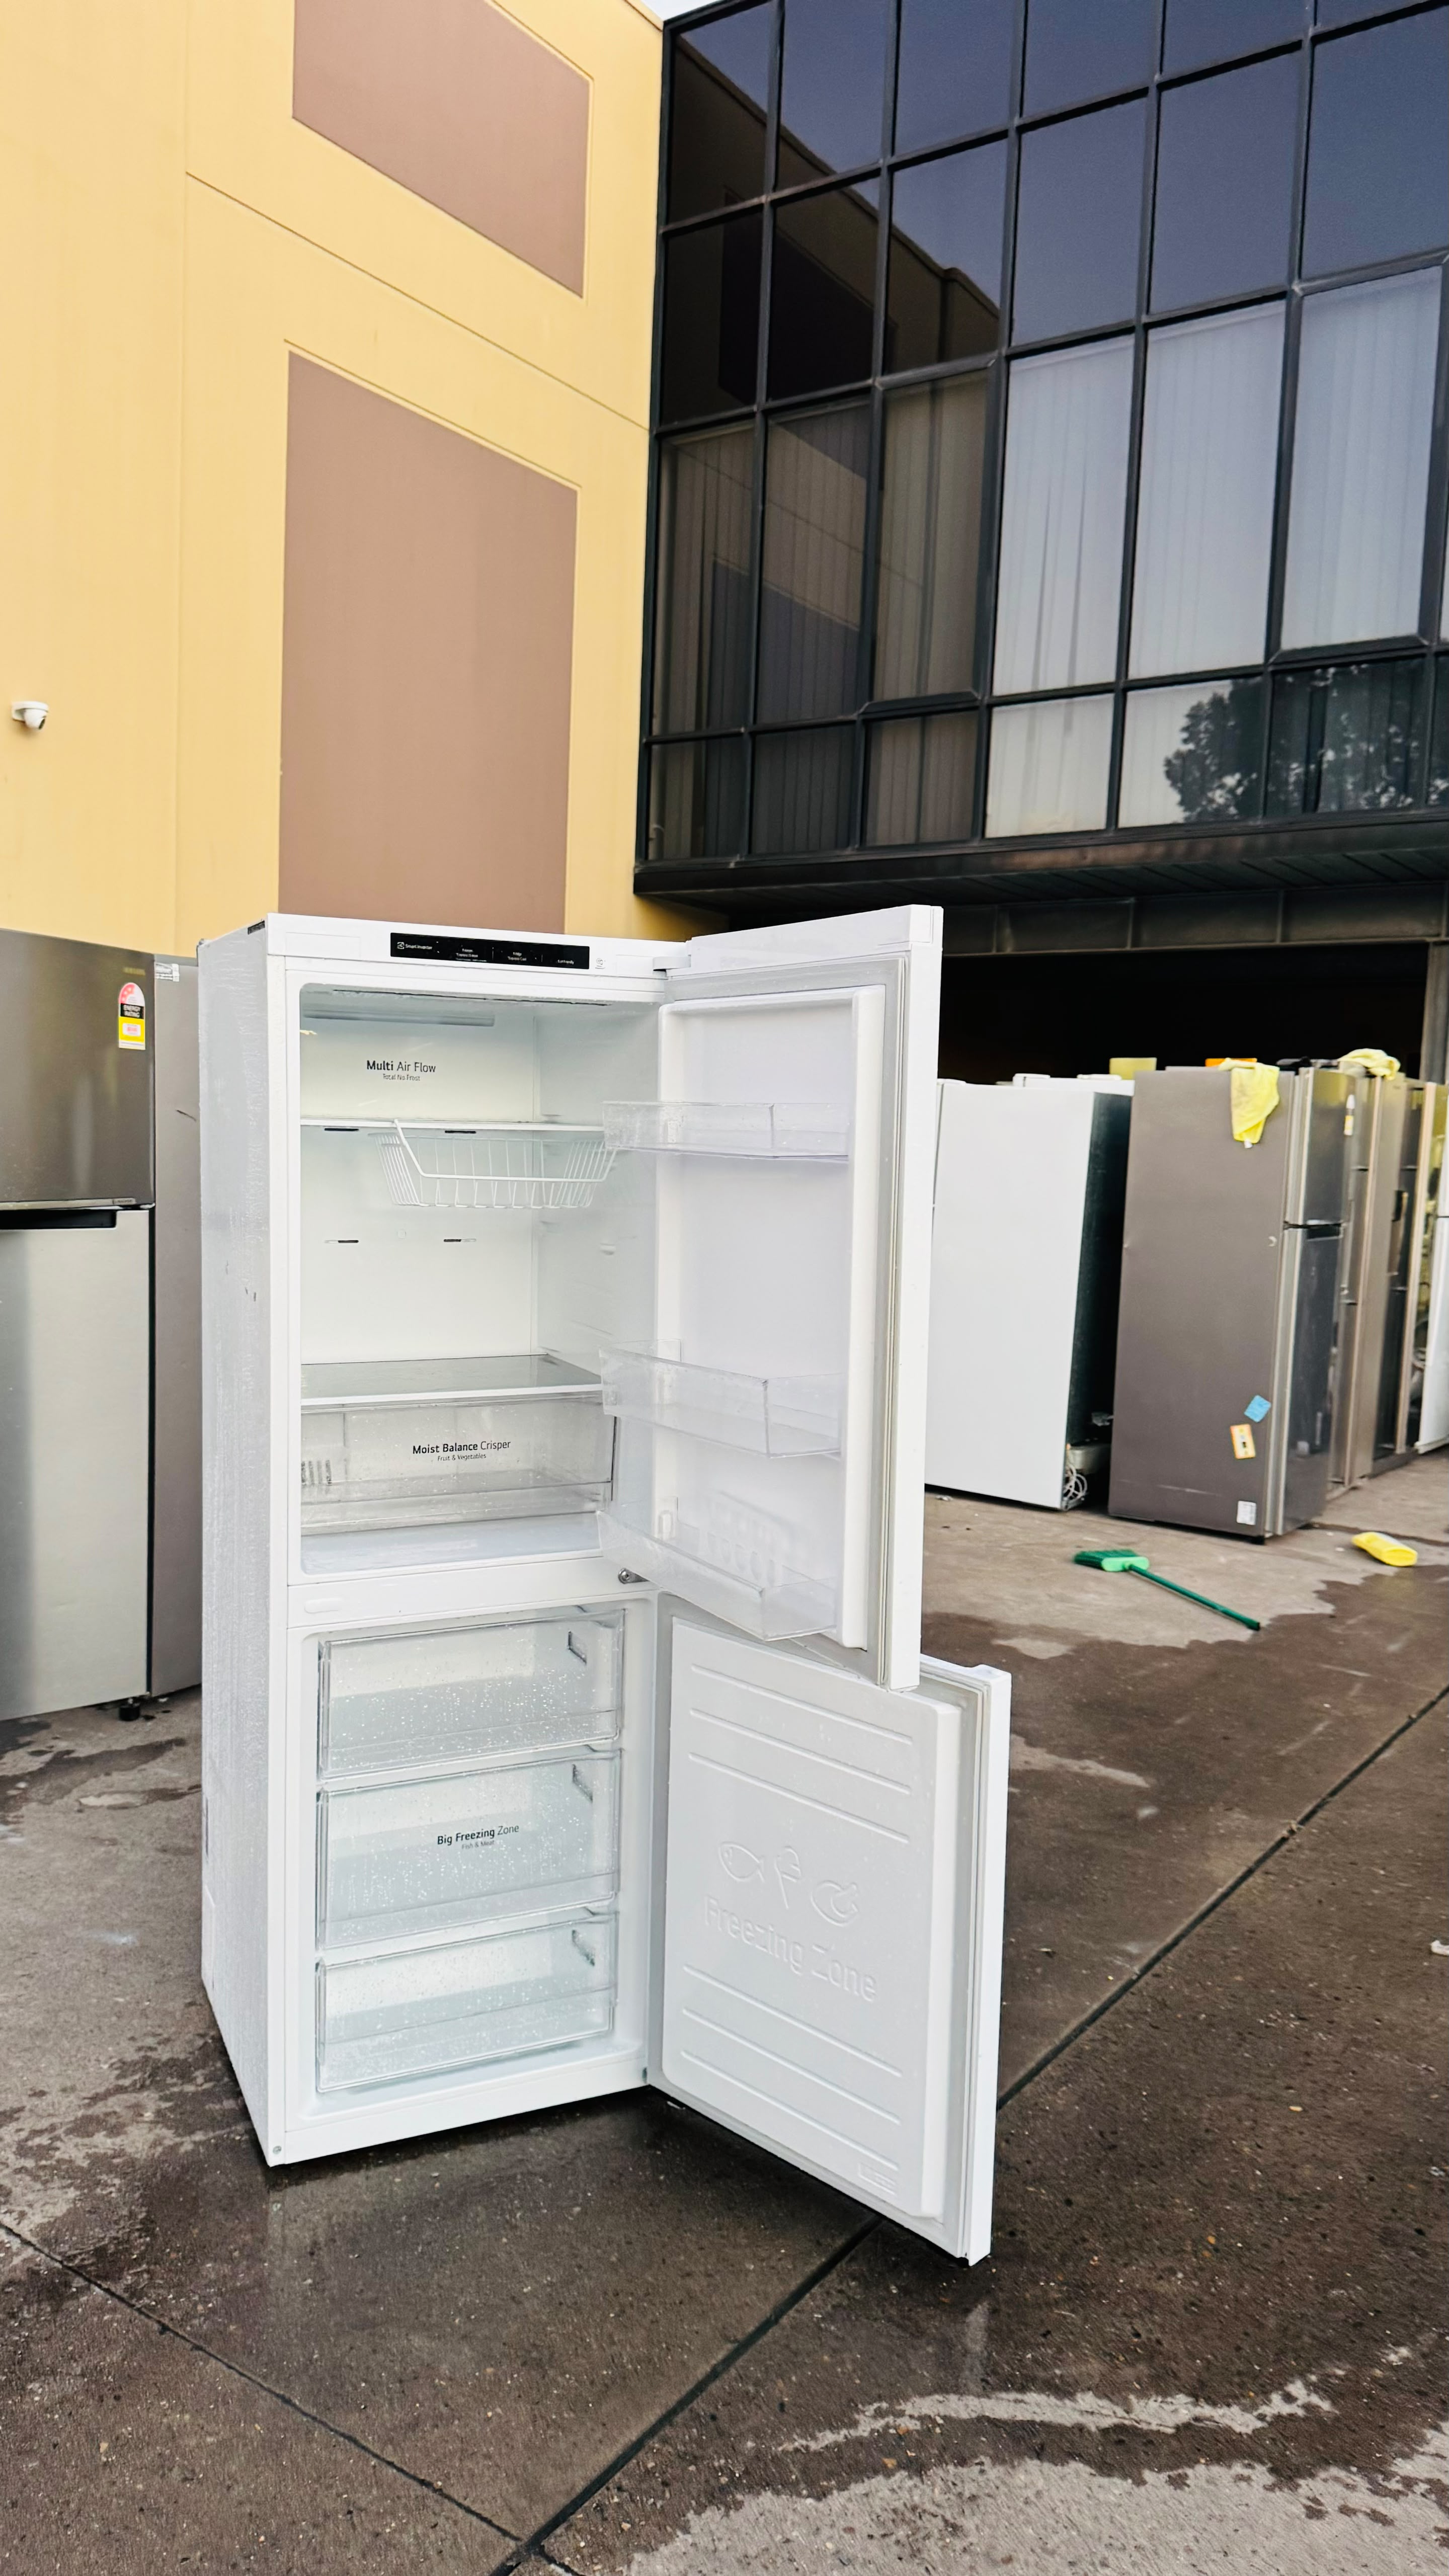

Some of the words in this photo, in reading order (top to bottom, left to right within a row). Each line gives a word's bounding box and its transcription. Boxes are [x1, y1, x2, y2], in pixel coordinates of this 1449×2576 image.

[367, 1060, 393, 1071] Multi
[396, 1061, 411, 1071] Air
[414, 1062, 436, 1072] Flow
[413, 1444, 440, 1455] Moist
[443, 1442, 478, 1453] Balance
[480, 1440, 511, 1451] Crisper
[458, 1453, 487, 1461] Vegetables
[437, 1834, 452, 1846] Big
[456, 1828, 495, 1842] Freezing
[497, 1825, 519, 1835] Zone
[705, 1894, 804, 1976] Freezing
[811, 1945, 877, 2002] Zone
